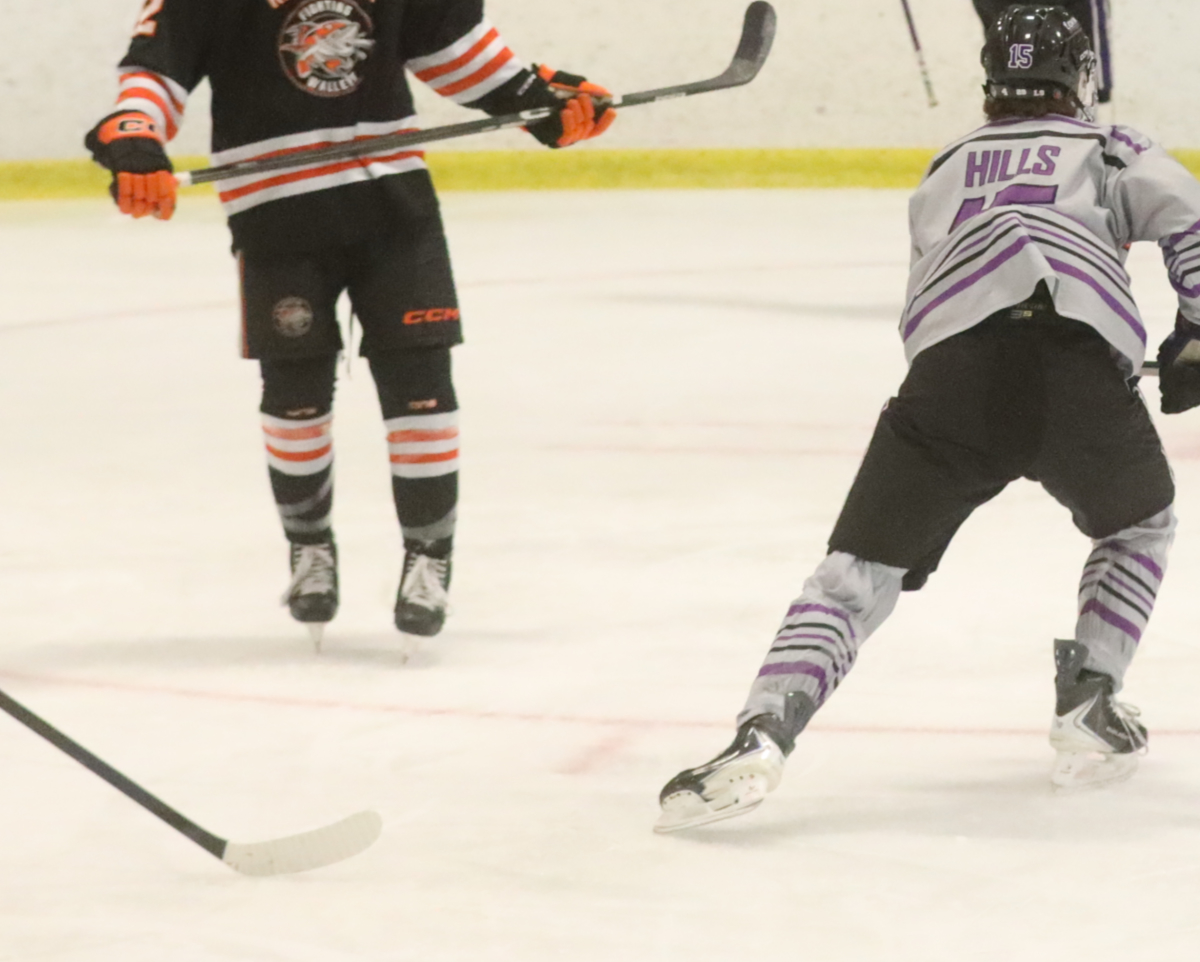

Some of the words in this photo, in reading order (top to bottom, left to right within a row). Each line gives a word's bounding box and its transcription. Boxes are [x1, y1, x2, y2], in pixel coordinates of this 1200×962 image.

[1007, 44, 1034, 69] 15
[306, 70, 360, 93] WALLEY
[964, 145, 1062, 188] HILLS
[402, 307, 459, 325] CCM
